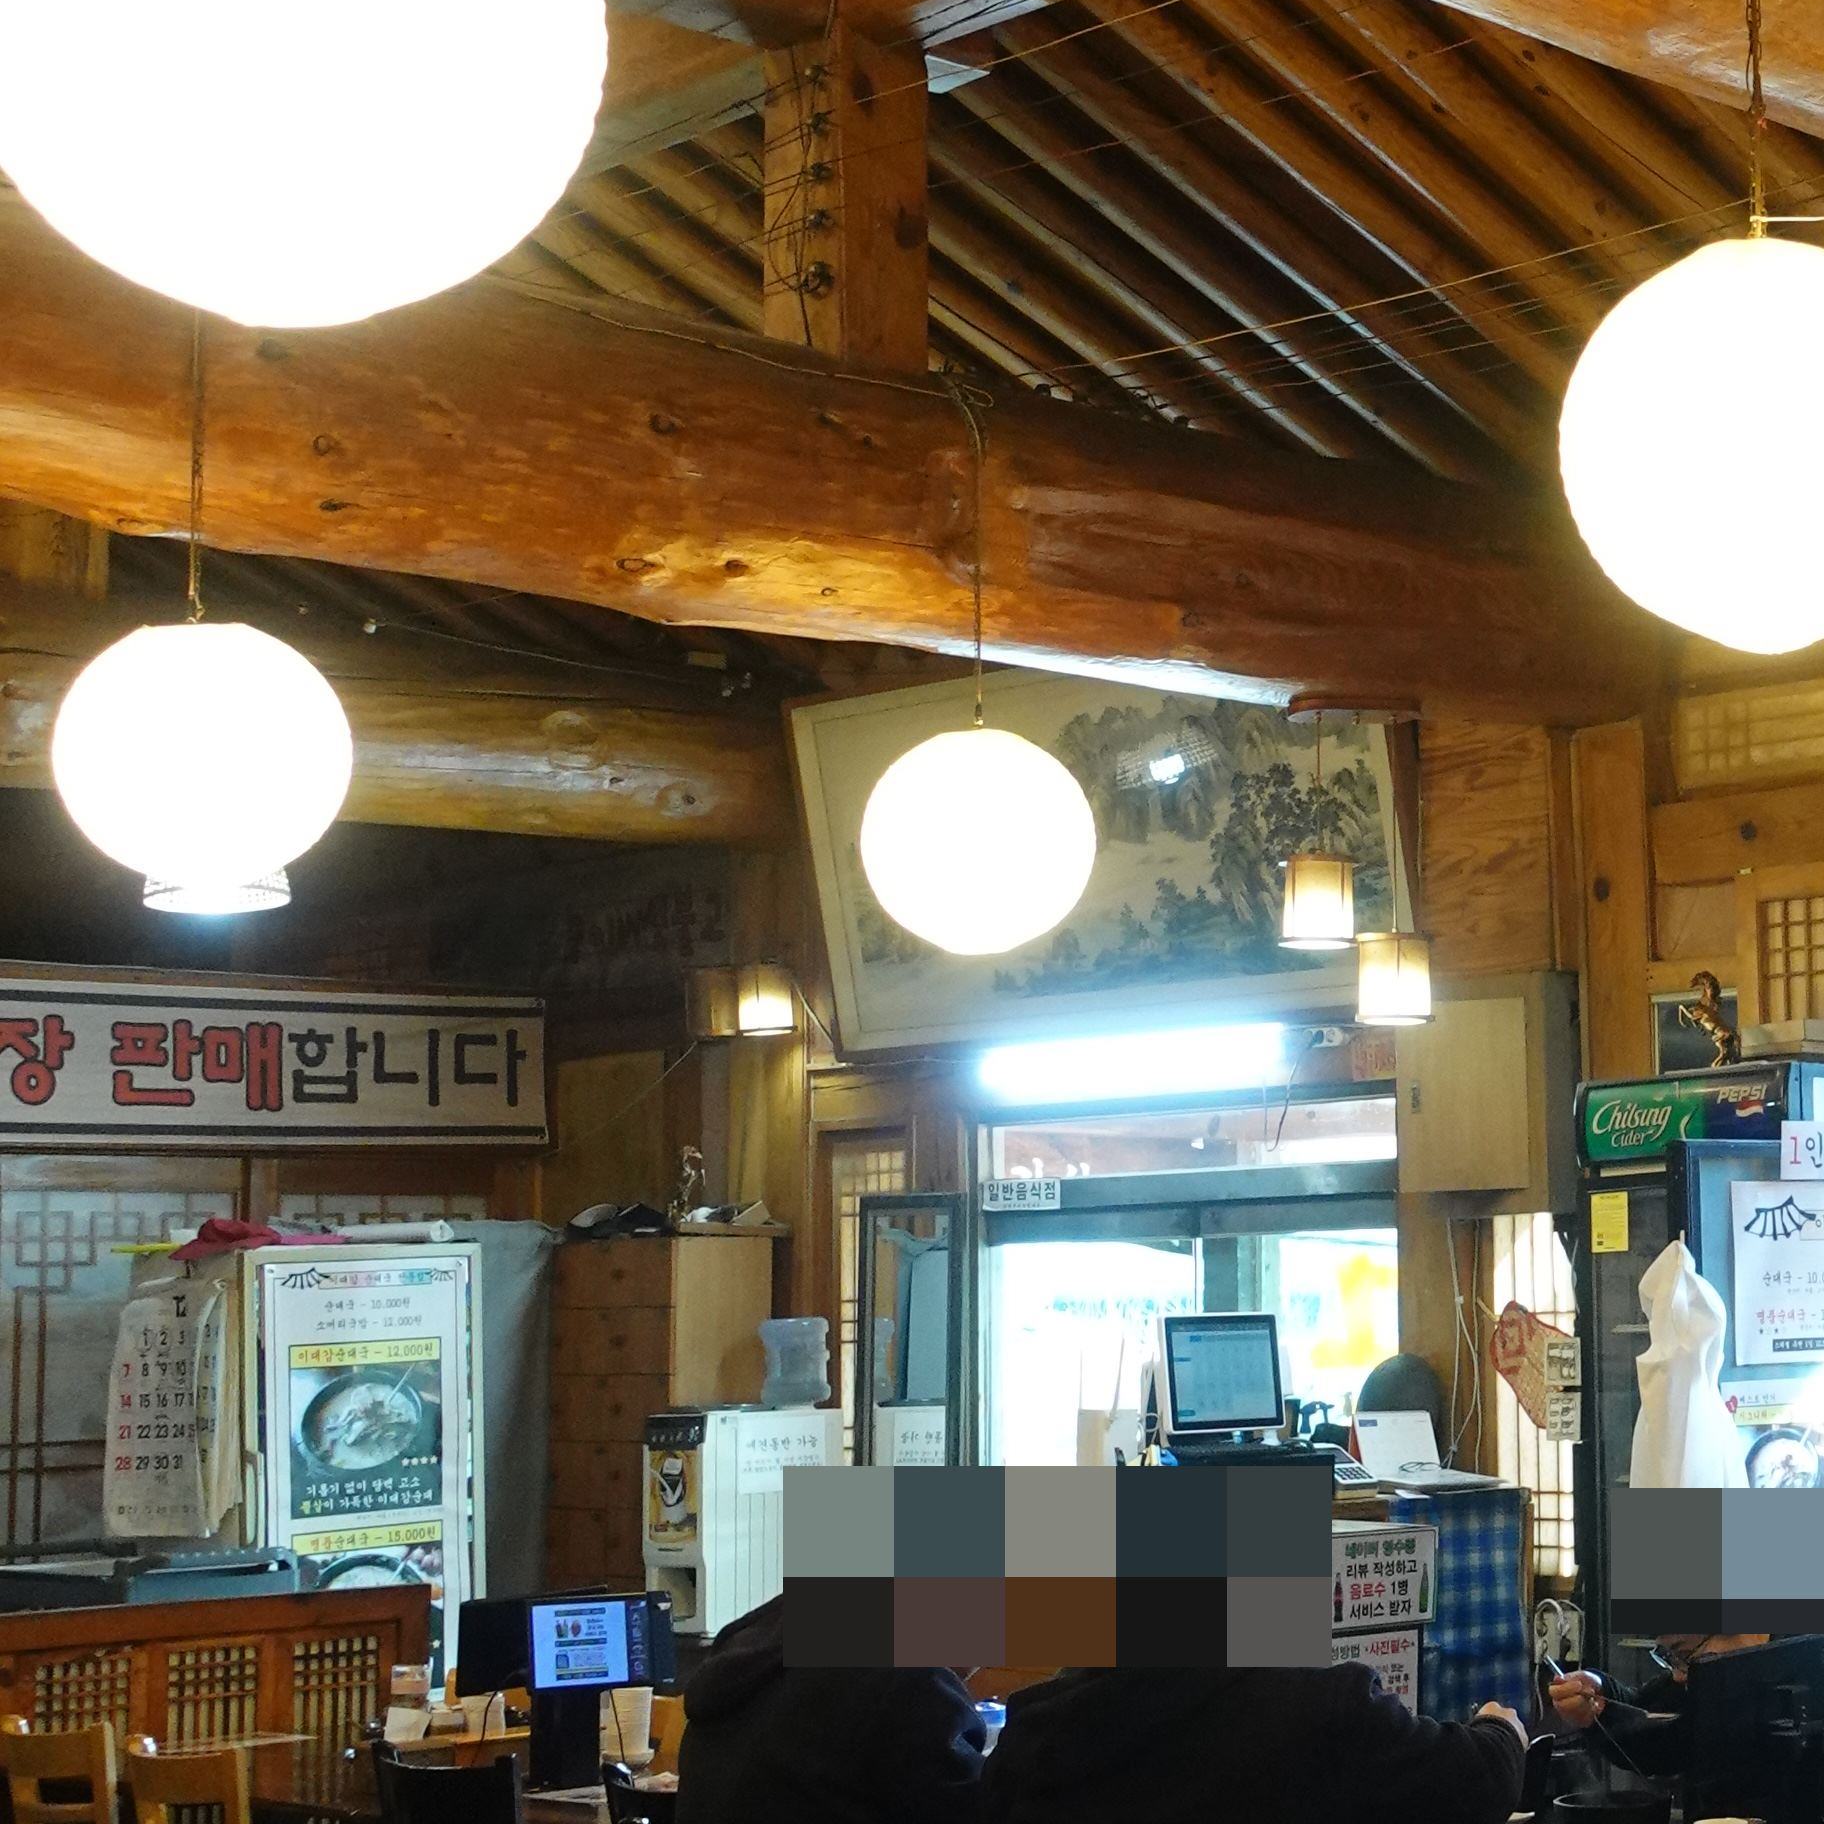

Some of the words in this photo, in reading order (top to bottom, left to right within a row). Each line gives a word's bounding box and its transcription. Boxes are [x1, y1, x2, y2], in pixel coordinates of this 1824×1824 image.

[110, 1018, 528, 1112] 판매합니다
[1717, 1084, 1768, 1104] PEPSI
[1593, 1099, 1673, 1142] Chilsung
[1611, 1130, 1648, 1148] Cider
[1789, 1131, 1823, 1168] 1인
[988, 1181, 1056, 1202] 일반음식점
[1762, 1270, 1793, 1287] 순대국
[324, 1299, 355, 1313] 순대국
[160, 1331, 168, 1346] 2
[298, 1346, 369, 1365] 이대감순대국
[141, 1362, 149, 1377] 8
[139, 1394, 151, 1408] 15
[156, 1393, 168, 1408] 16
[174, 1392, 185, 1408] 17
[118, 1424, 132, 1440] 21
[136, 1424, 151, 1439] 22
[154, 1424, 169, 1439] 23
[172, 1423, 185, 1439] 24
[115, 1456, 133, 1471] 28
[135, 1455, 150, 1471] 29
[153, 1456, 169, 1470] 30
[172, 1454, 183, 1470] 31
[310, 1533, 369, 1552] 명품순대국
[1345, 1541, 1379, 1559] 네이버
[1346, 1563, 1369, 1579] 리뷰
[1373, 1559, 1417, 1577] 작성하고
[1350, 1581, 1386, 1600] 음료수
[1391, 1579, 1409, 1596] 1병
[1349, 1602, 1385, 1620] 서비스
[1389, 1598, 1411, 1617] 받자
